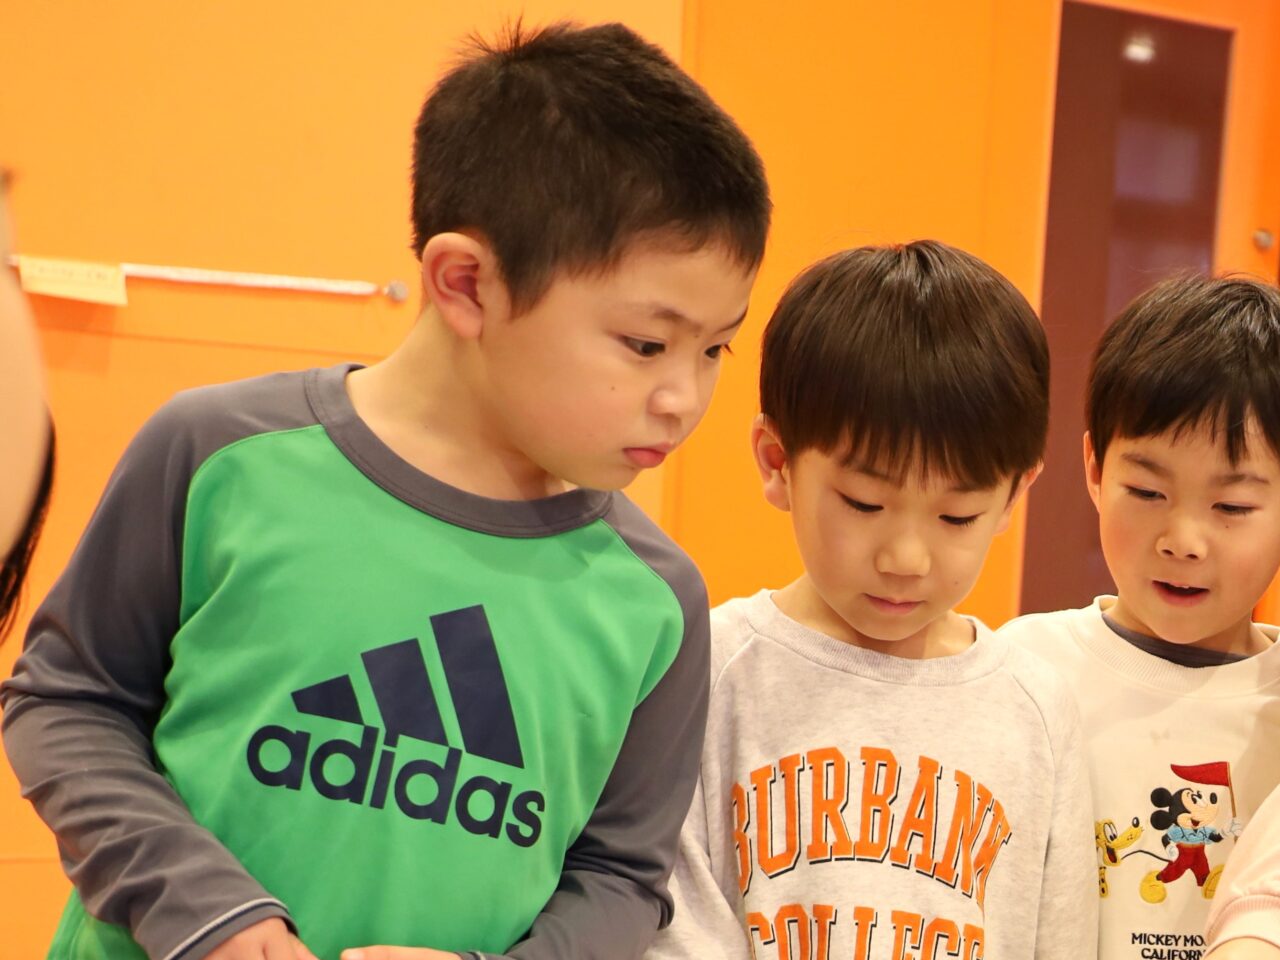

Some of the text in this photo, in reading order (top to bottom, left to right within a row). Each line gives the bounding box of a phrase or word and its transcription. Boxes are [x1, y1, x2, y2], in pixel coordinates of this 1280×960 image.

[247, 724, 545, 848] adidas
[731, 746, 1012, 914] BURBANK
[1131, 933, 1207, 947] MICKEY MO
